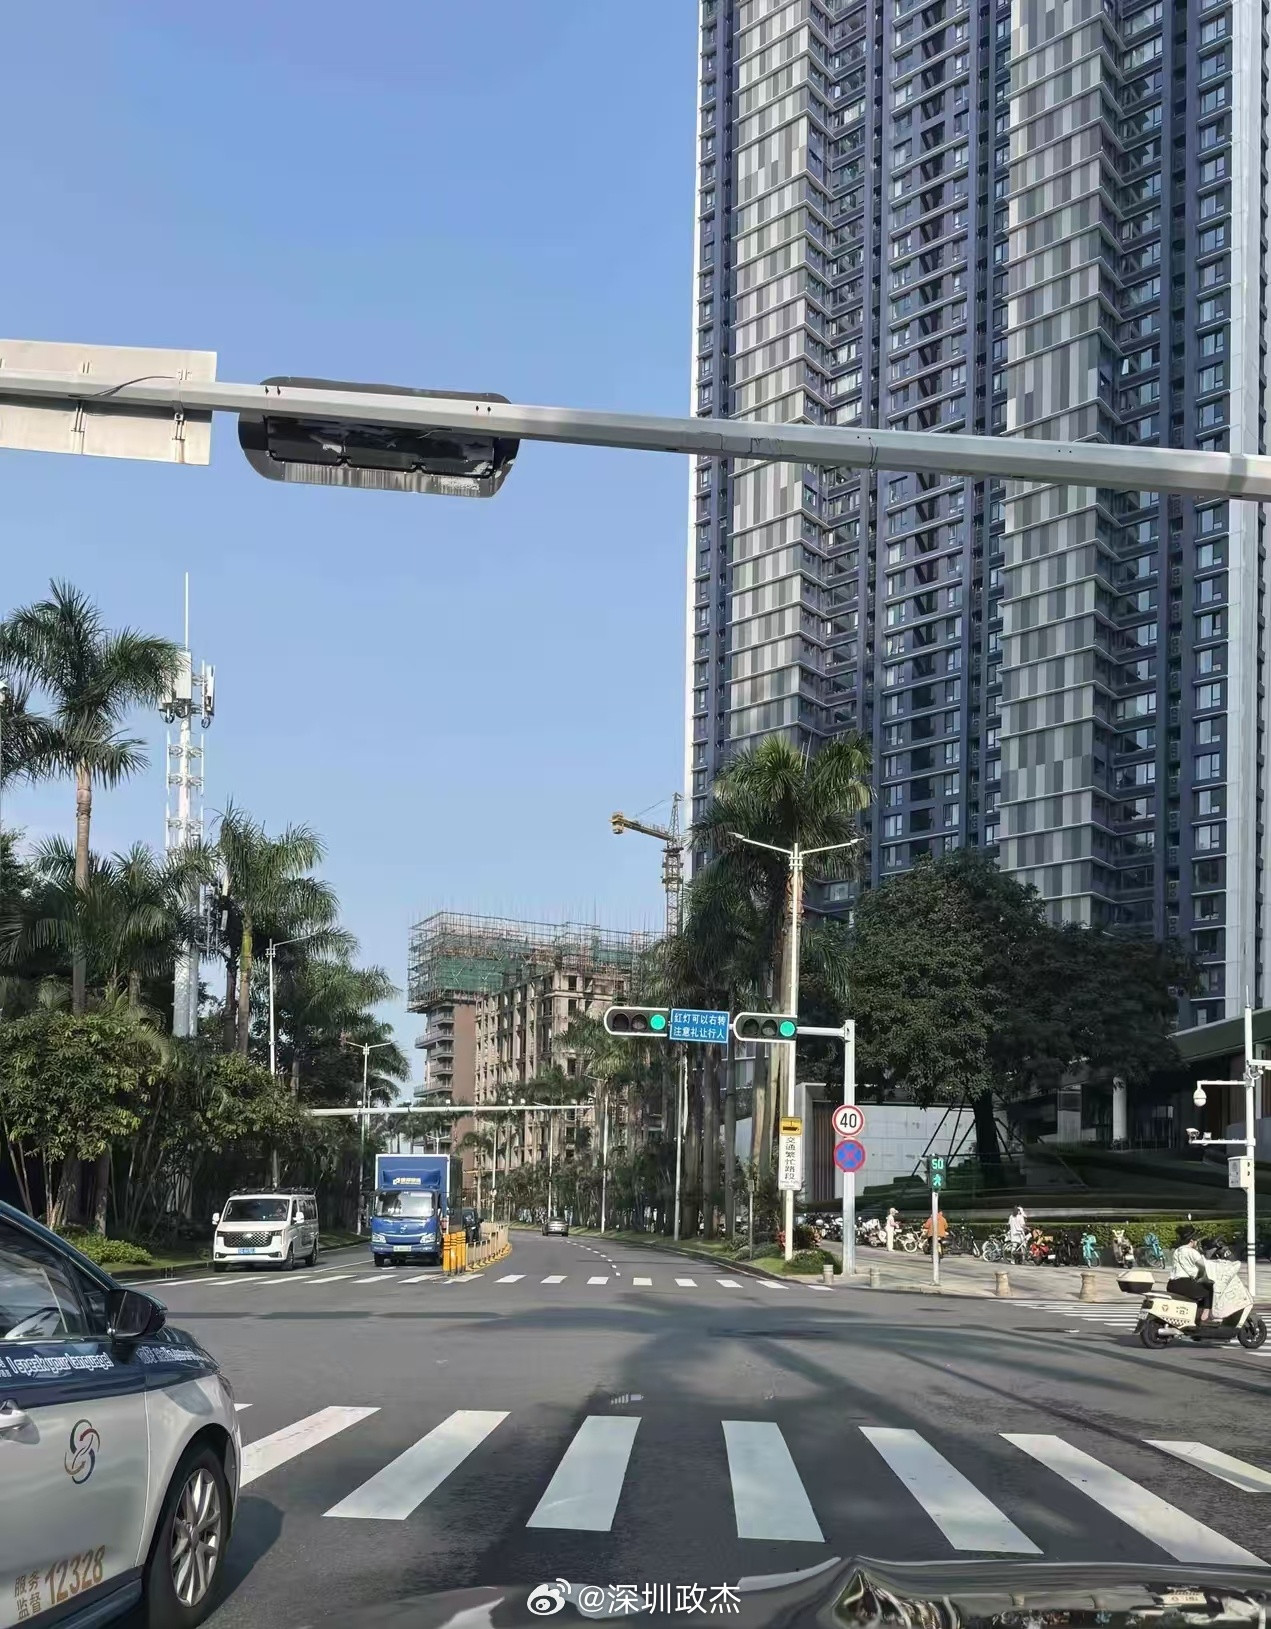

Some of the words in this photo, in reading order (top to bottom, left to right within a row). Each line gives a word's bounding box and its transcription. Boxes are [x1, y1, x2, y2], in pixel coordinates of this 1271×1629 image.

[674, 1013, 727, 1026] 红灯可以右转
[673, 1026, 725, 1039] 注意礼让行人
[840, 1113, 857, 1128] 40
[784, 1136, 796, 1180] 交通繁忙路段
[931, 1158, 944, 1170] 50
[14, 1354, 51, 1376] speak
[44, 1357, 72, 1374] your
[14, 1569, 40, 1597] 服务
[44, 1544, 106, 1605] 12328
[16, 1591, 42, 1621] 监督
